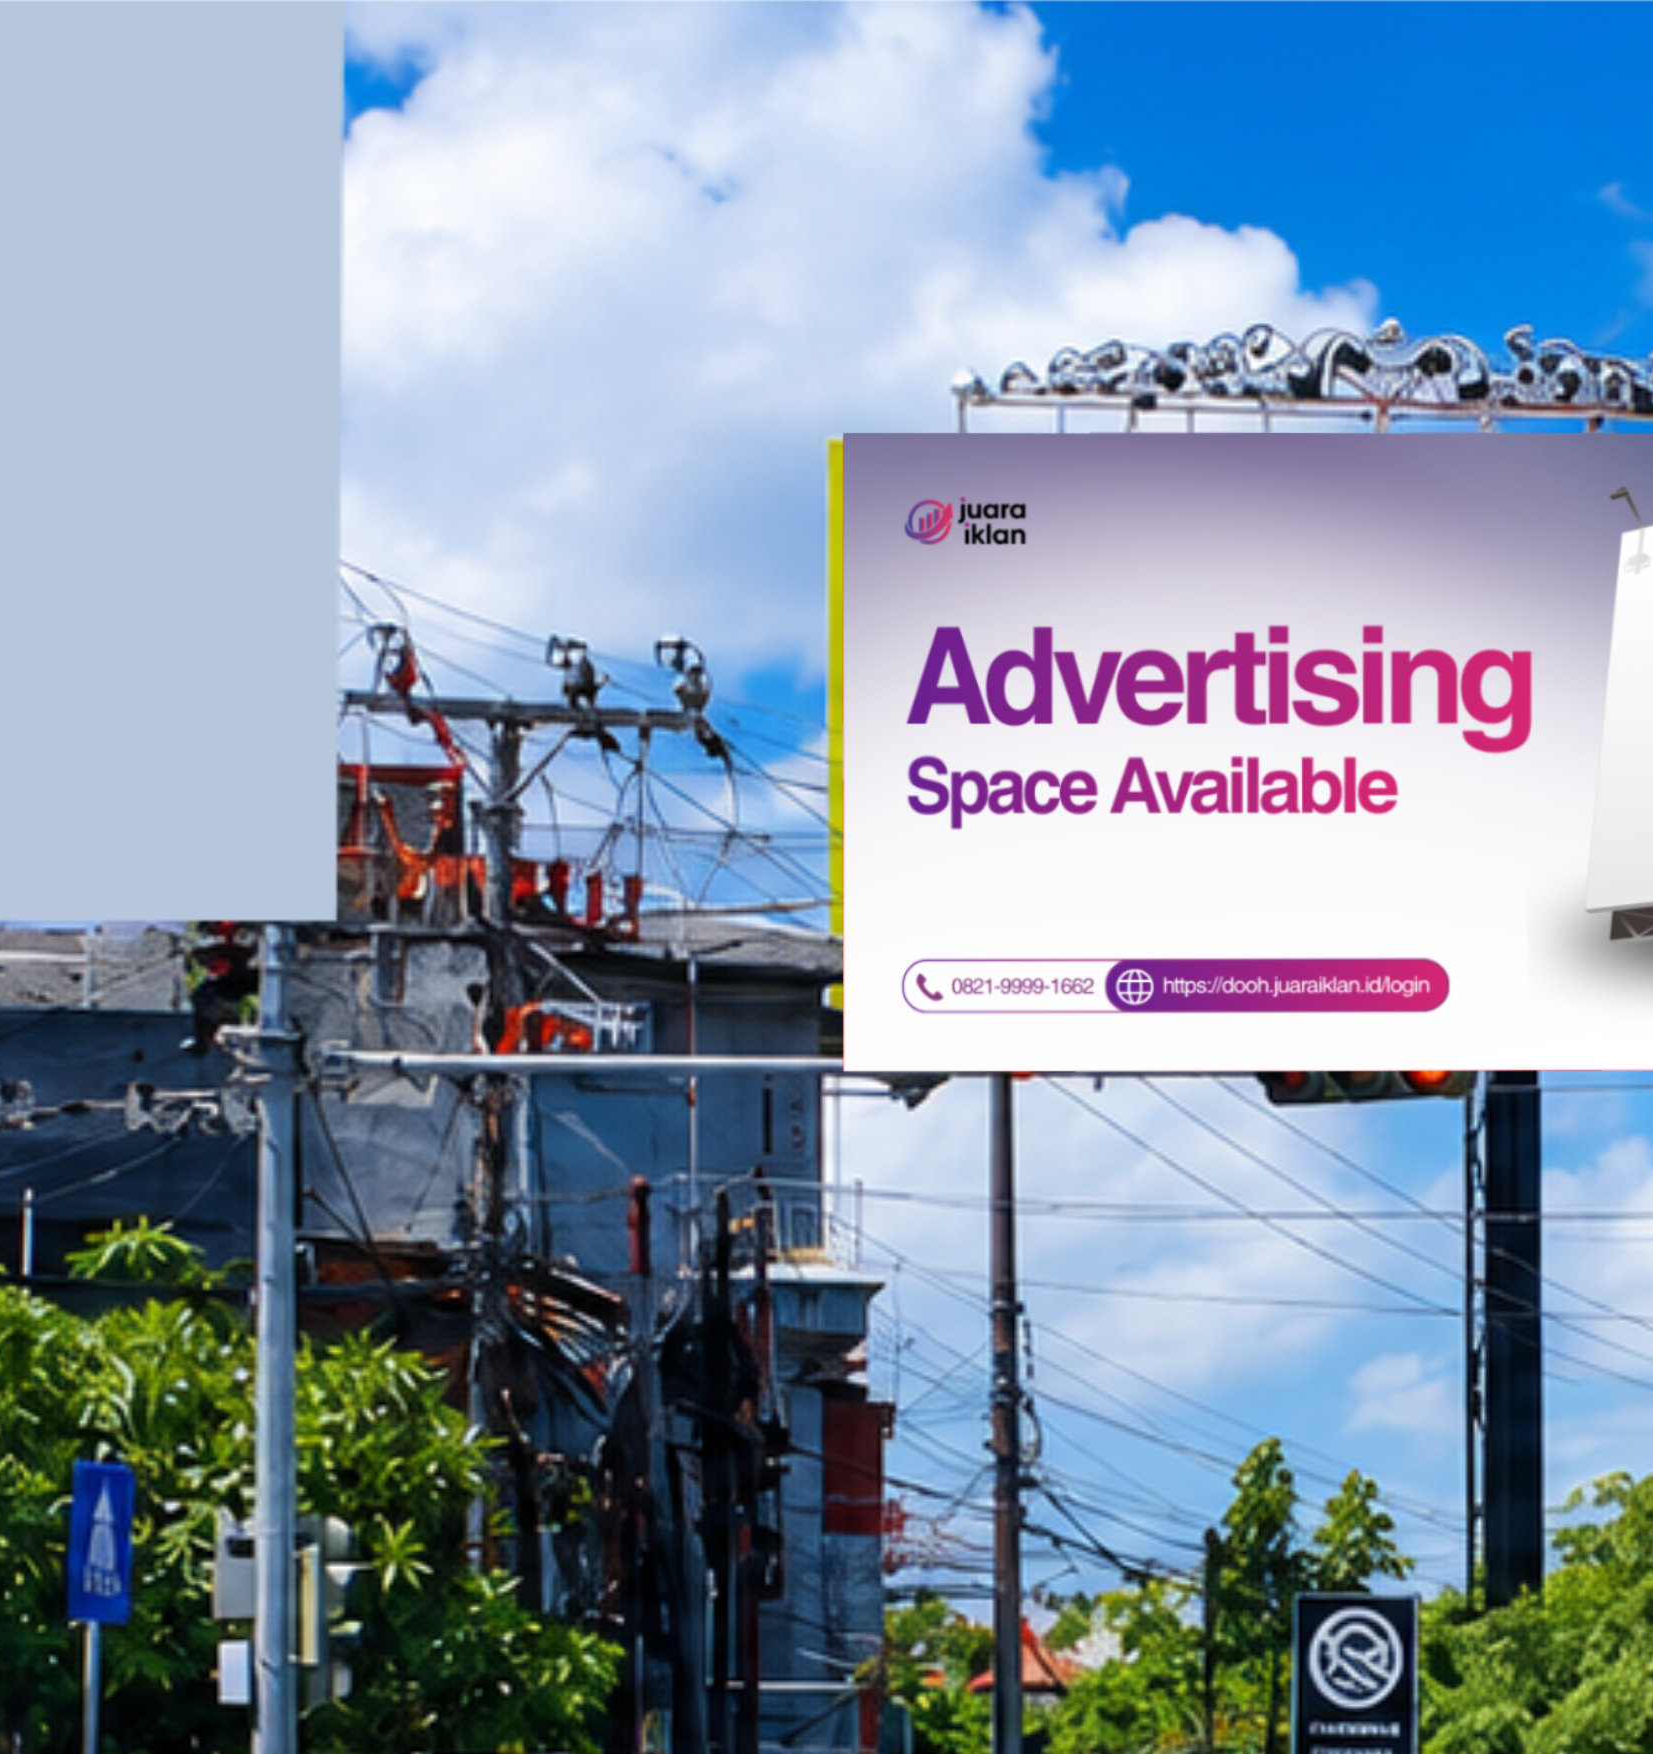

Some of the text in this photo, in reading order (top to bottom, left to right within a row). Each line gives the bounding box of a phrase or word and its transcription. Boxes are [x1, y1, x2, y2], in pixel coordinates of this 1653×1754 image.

[957, 496, 1027, 524] juara
[964, 521, 1027, 545] iklan
[906, 625, 1533, 754] Advertising
[907, 755, 1399, 831] Space Available
[951, 975, 1431, 997] 0821-9999-1662 https://dooh.juaraiklan.id/login
